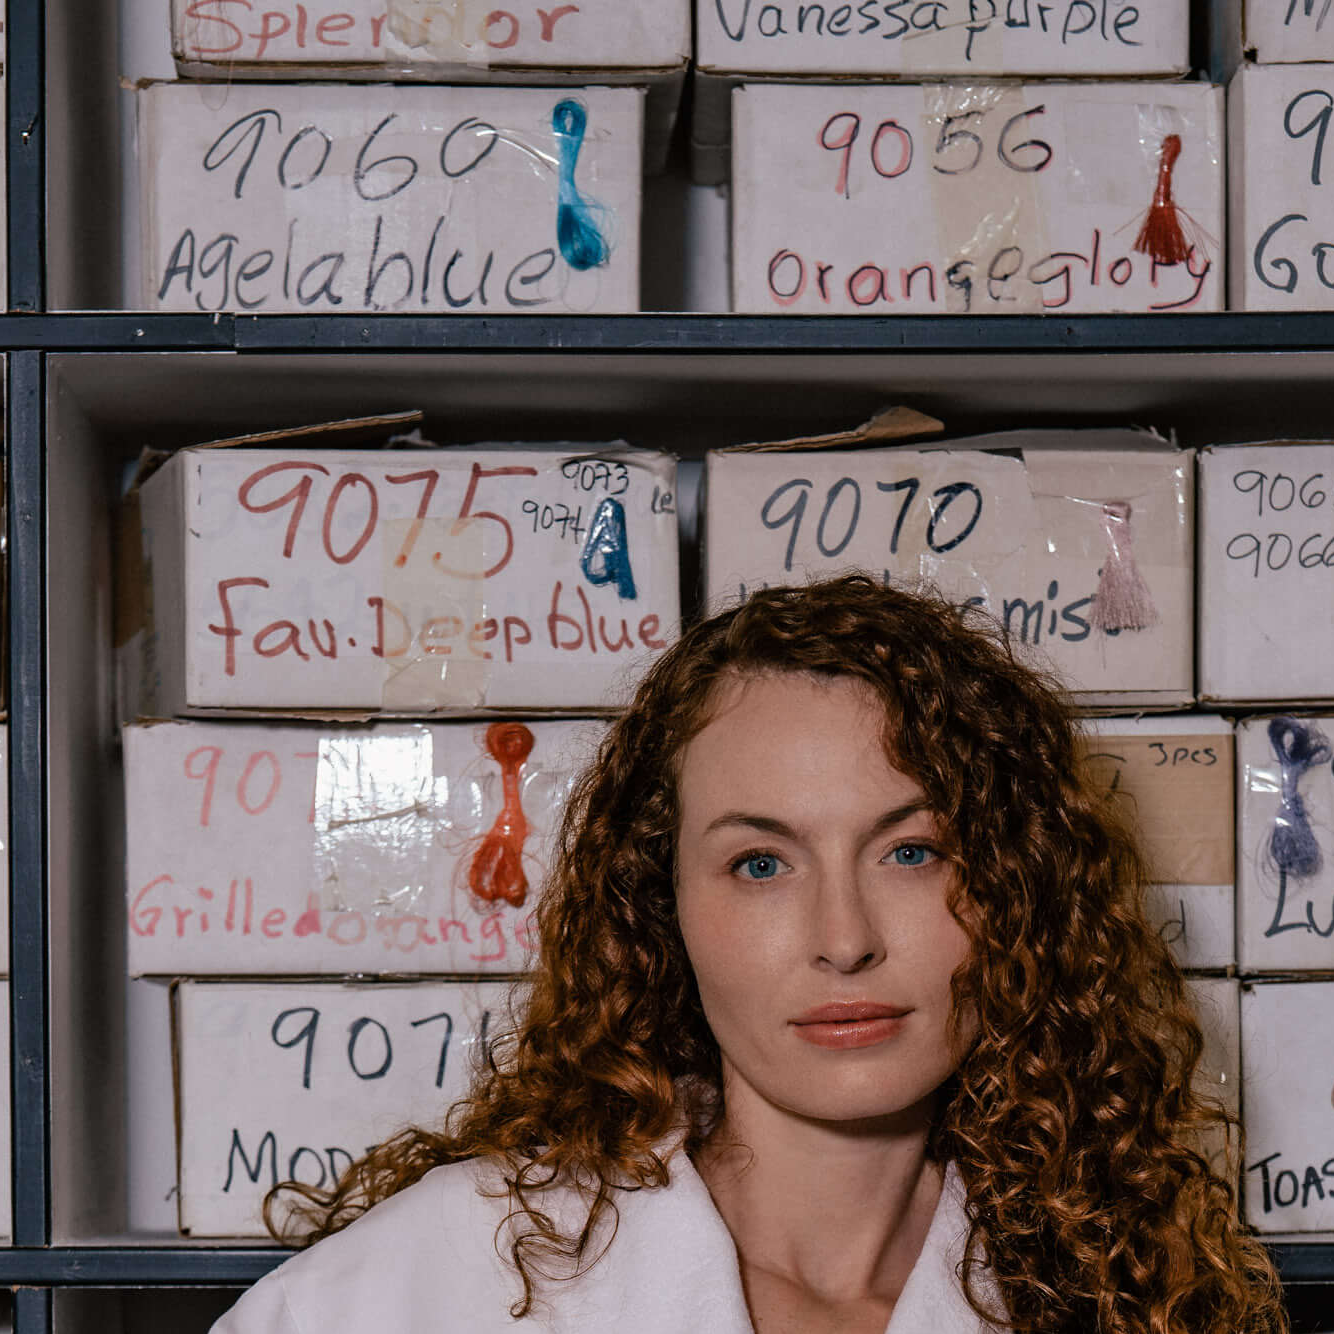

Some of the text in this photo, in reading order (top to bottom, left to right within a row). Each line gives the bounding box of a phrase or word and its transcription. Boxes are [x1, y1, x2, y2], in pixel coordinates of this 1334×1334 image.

[184, 0, 579, 58] Splenor
[203, 108, 501, 200] 9060
[818, 104, 1053, 200] 9056
[768, 229, 1212, 311] Orangeglory
[238, 460, 538, 579] 9075
[561, 459, 630, 496] 9073
[760, 476, 983, 572] 9070
